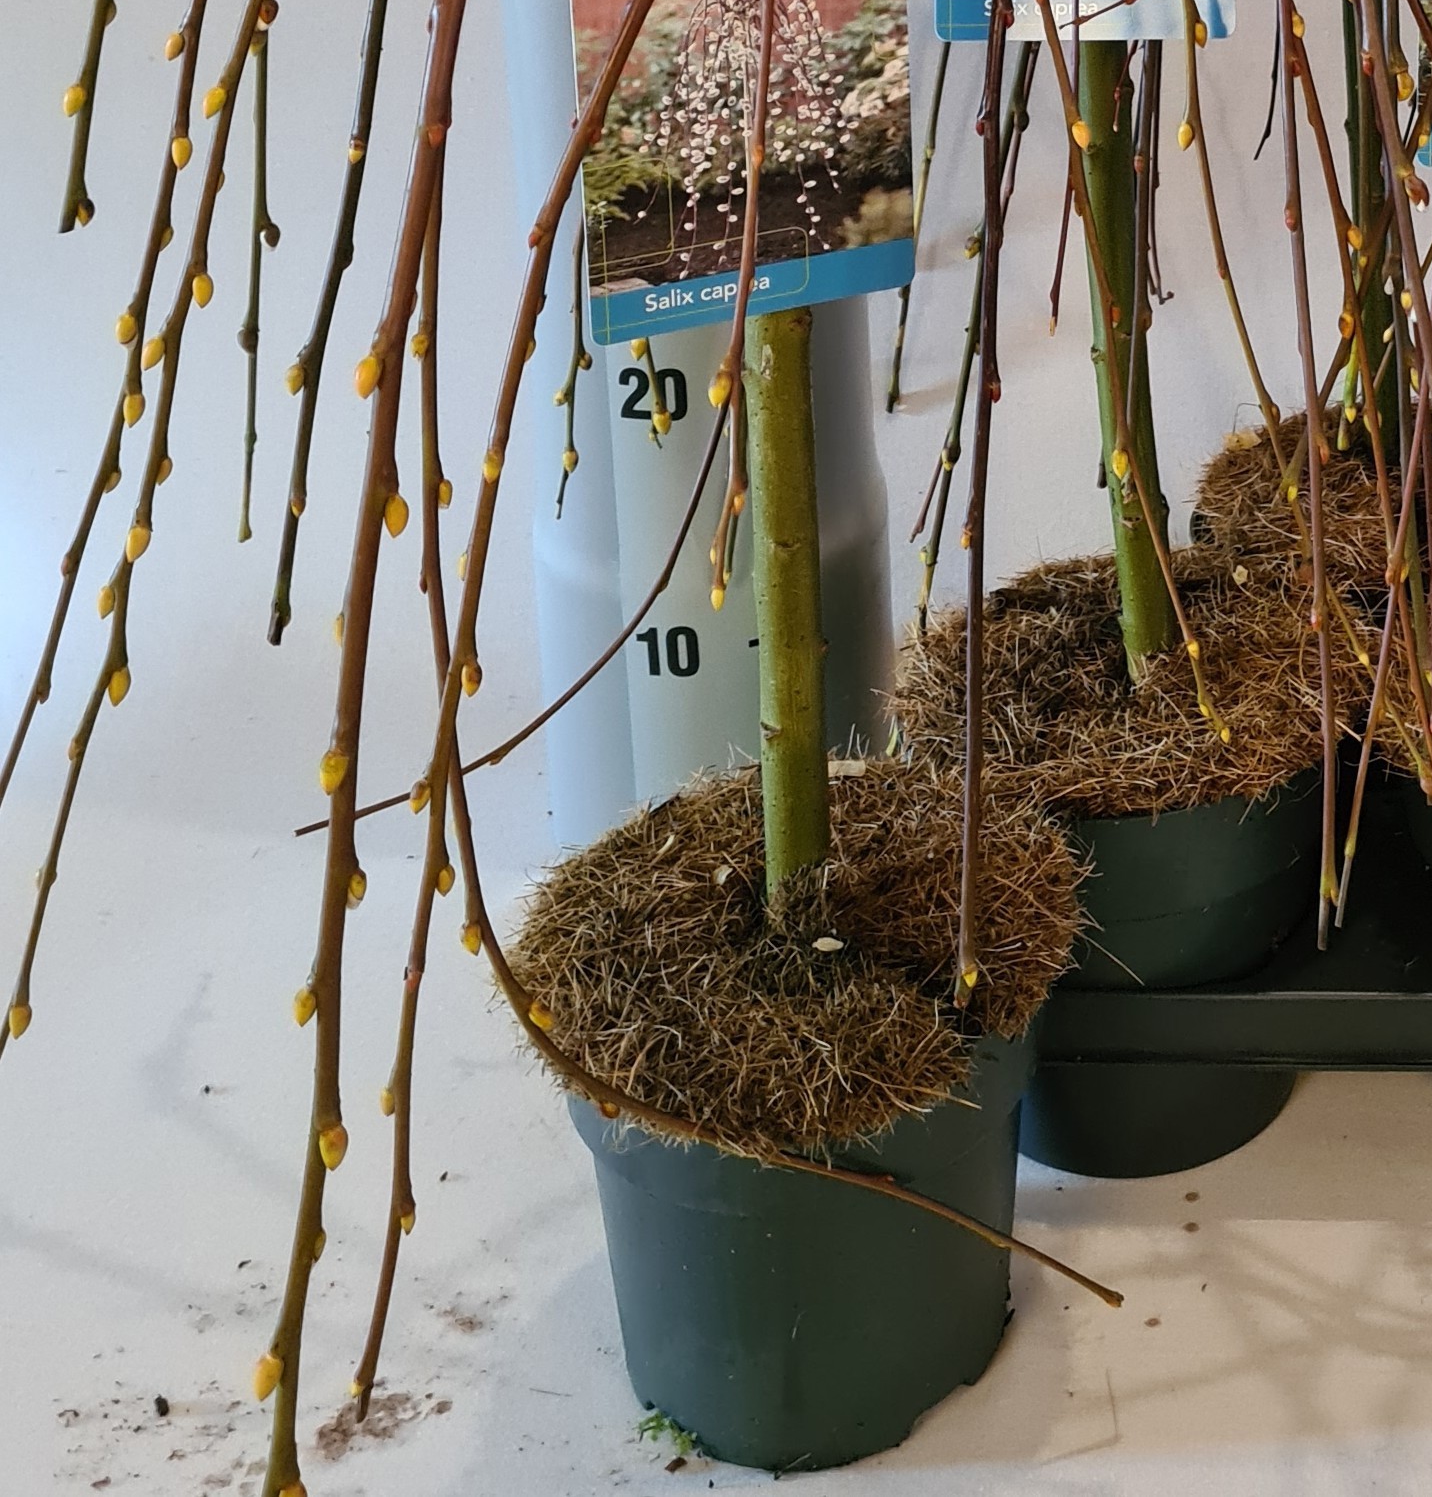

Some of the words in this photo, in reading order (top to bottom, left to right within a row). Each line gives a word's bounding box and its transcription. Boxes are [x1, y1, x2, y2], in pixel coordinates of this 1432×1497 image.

[644, 288, 694, 312] Salix
[618, 367, 688, 421] 20
[636, 626, 700, 677] 10
